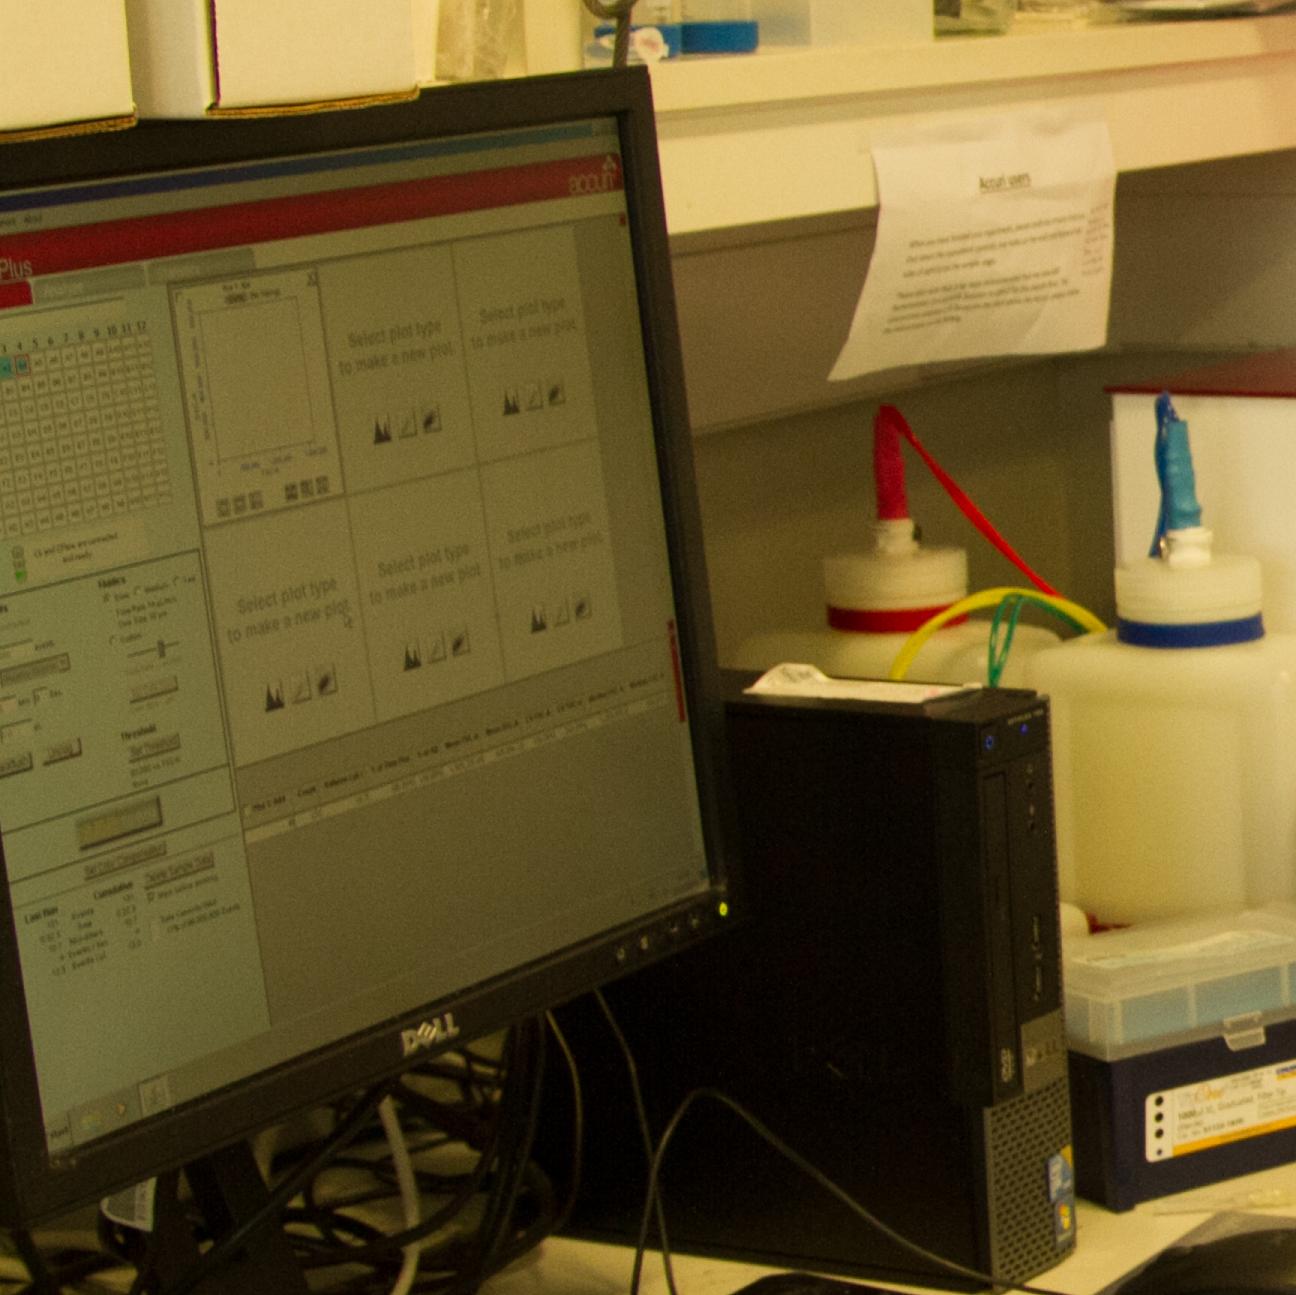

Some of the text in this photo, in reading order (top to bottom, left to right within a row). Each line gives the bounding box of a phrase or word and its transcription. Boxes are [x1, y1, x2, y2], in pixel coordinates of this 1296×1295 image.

[0, 256, 33, 280] Plus
[507, 511, 592, 543] Select plot type
[377, 543, 470, 577] Select plot type
[498, 556, 511, 570] to
[514, 548, 543, 567] make
[557, 539, 578, 554] new
[237, 577, 337, 615] Select plot type
[370, 590, 382, 605] to
[385, 580, 417, 600] make
[431, 572, 456, 588] new
[227, 627, 242, 643] to
[246, 619, 280, 639] make
[295, 608, 321, 624] new
[402, 1012, 460, 1057] DELL
